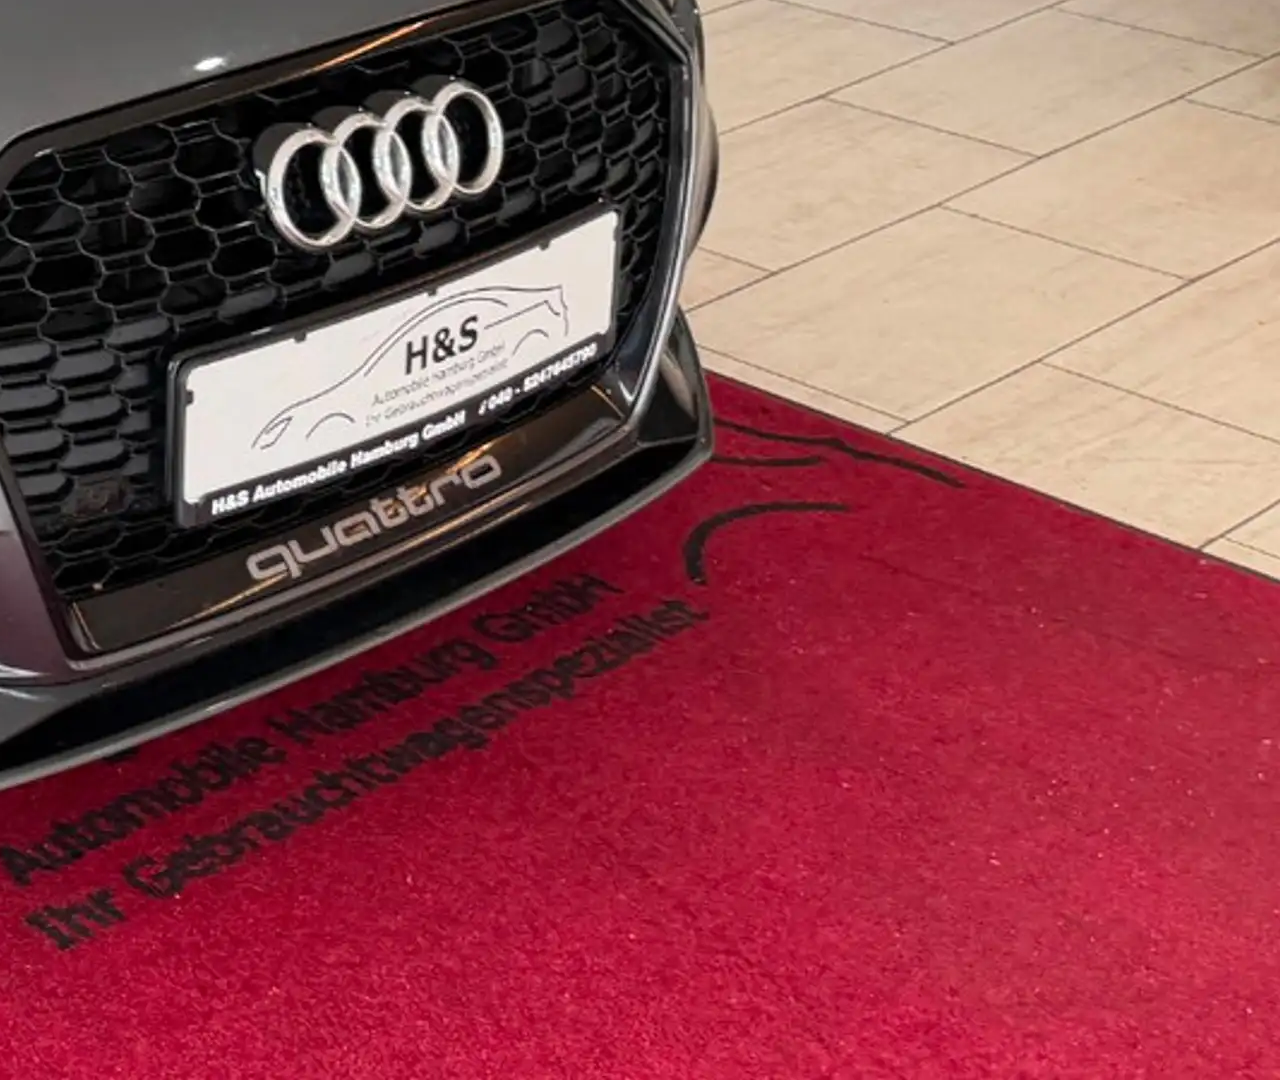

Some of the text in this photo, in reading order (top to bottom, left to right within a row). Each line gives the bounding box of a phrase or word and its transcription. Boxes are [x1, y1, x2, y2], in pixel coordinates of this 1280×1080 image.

[404, 314, 478, 375] H&S
[211, 489, 250, 516] H&S
[252, 459, 348, 503] Automobile
[349, 429, 420, 469] Hamburg
[421, 409, 466, 440] GmbH
[246, 454, 503, 580] quattro
[269, 636, 498, 746] Hamburg
[472, 572, 626, 644] GmbH
[23, 598, 711, 952] Ihr Gebrauchtwagenspezialist
